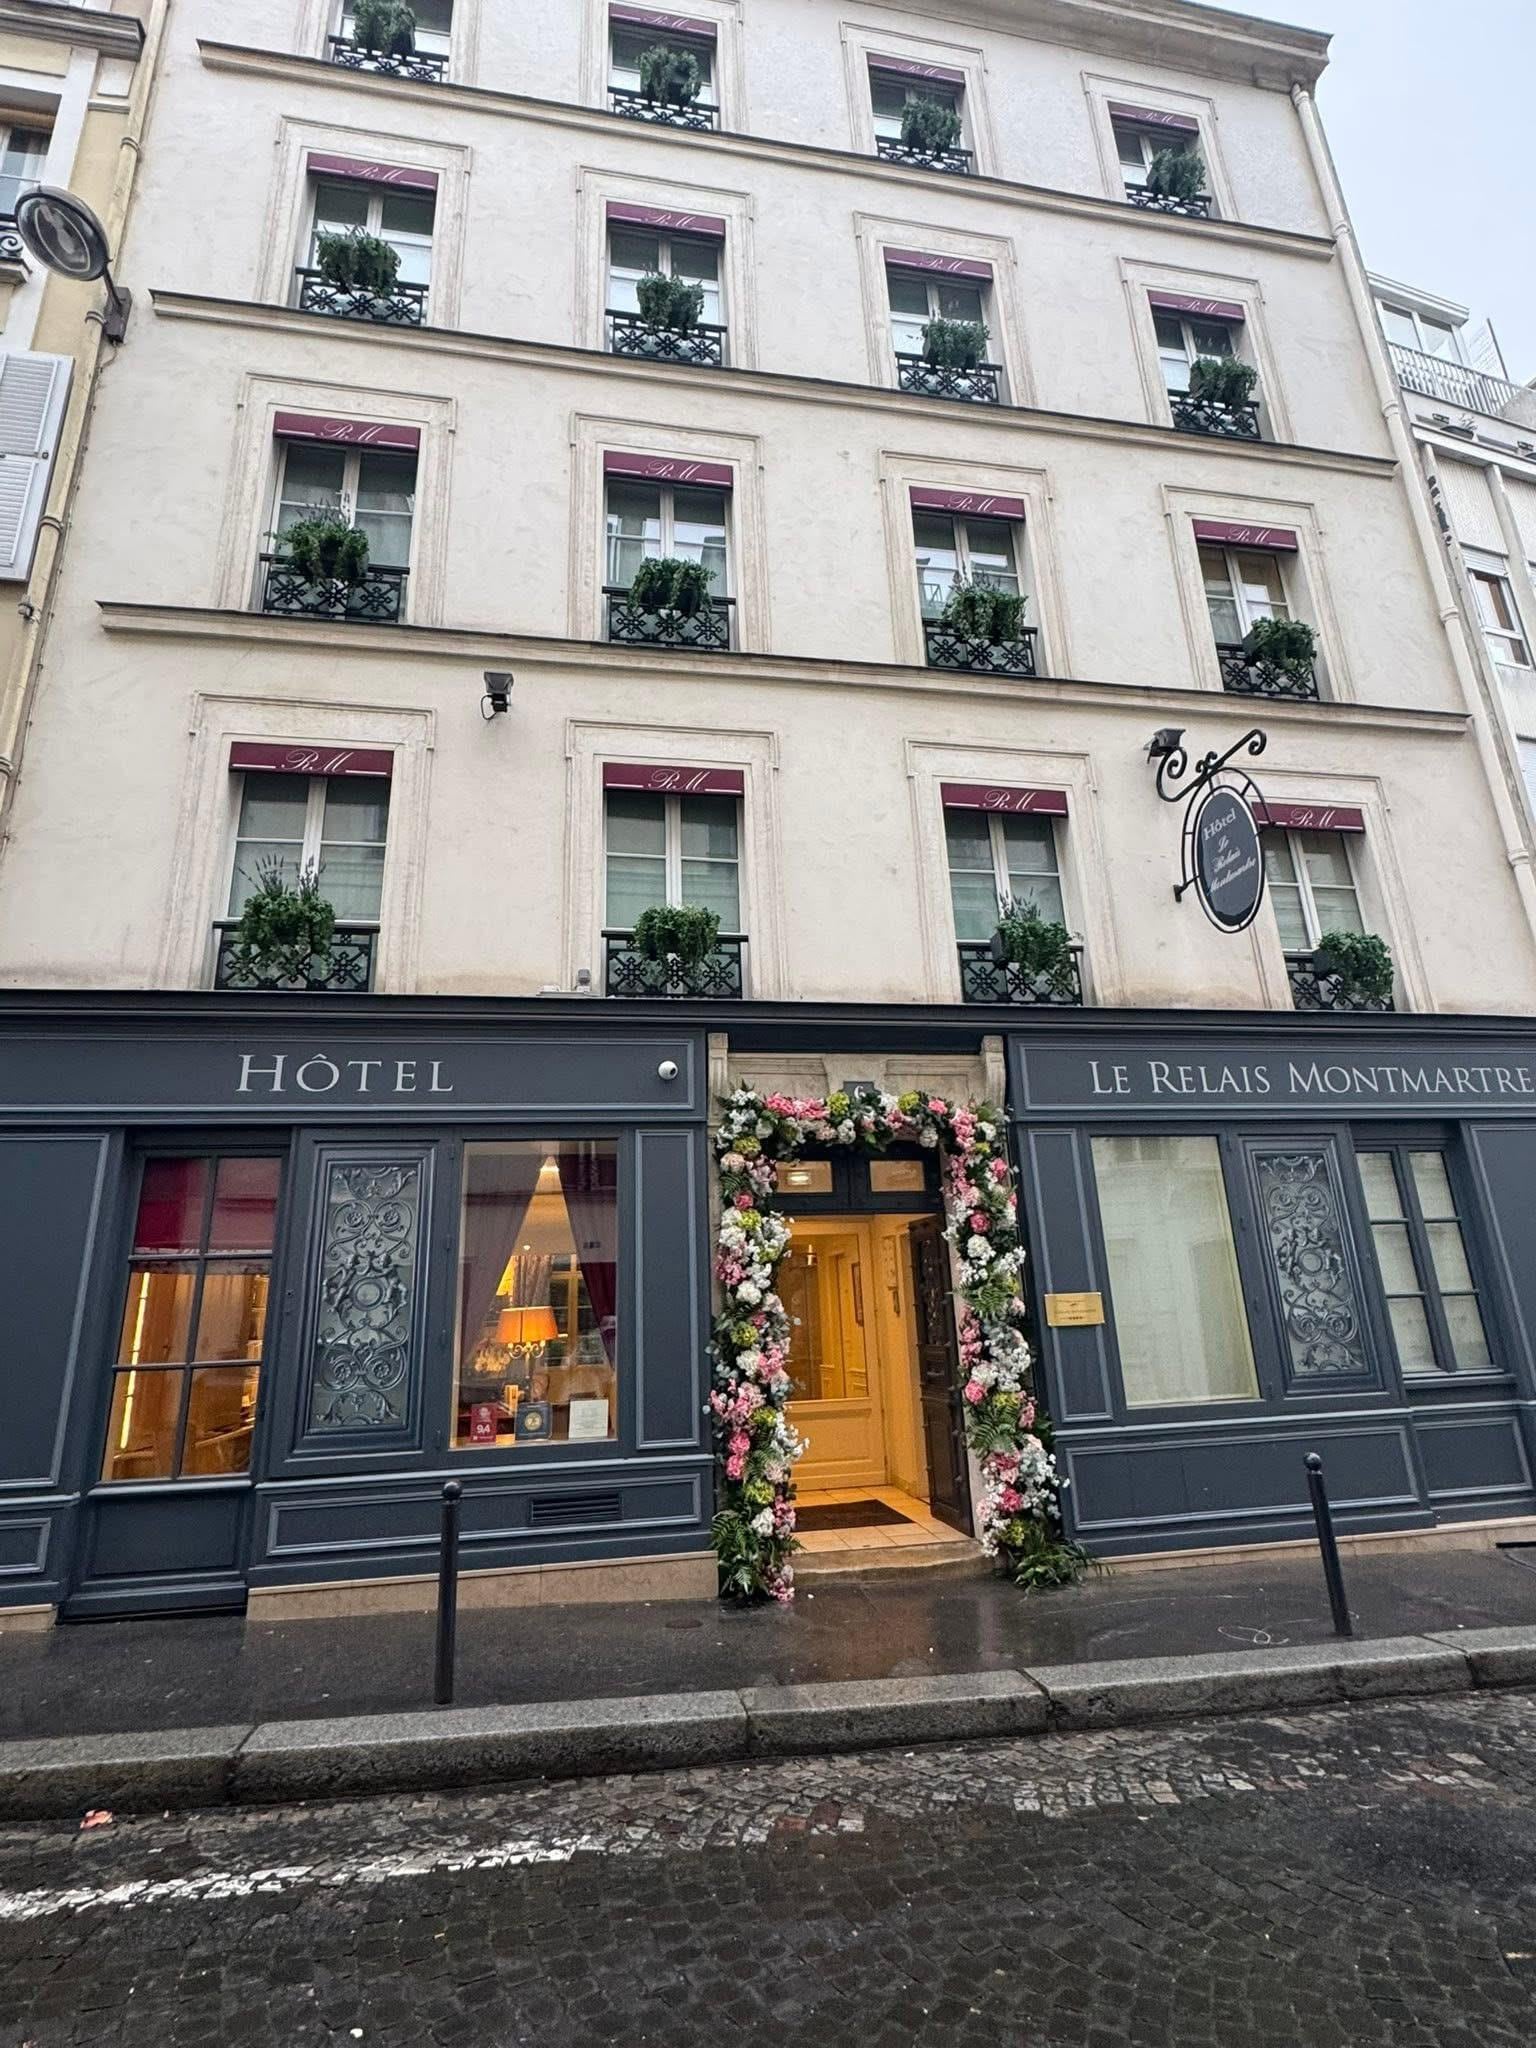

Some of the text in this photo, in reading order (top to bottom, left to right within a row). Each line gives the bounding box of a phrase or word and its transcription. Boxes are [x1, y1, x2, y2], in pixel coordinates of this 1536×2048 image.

[1203, 808, 1236, 841] Hôtel
[235, 1053, 454, 1092] HÔTEL
[1088, 1061, 1535, 1094] LE RELAIS MONTMARTRE
